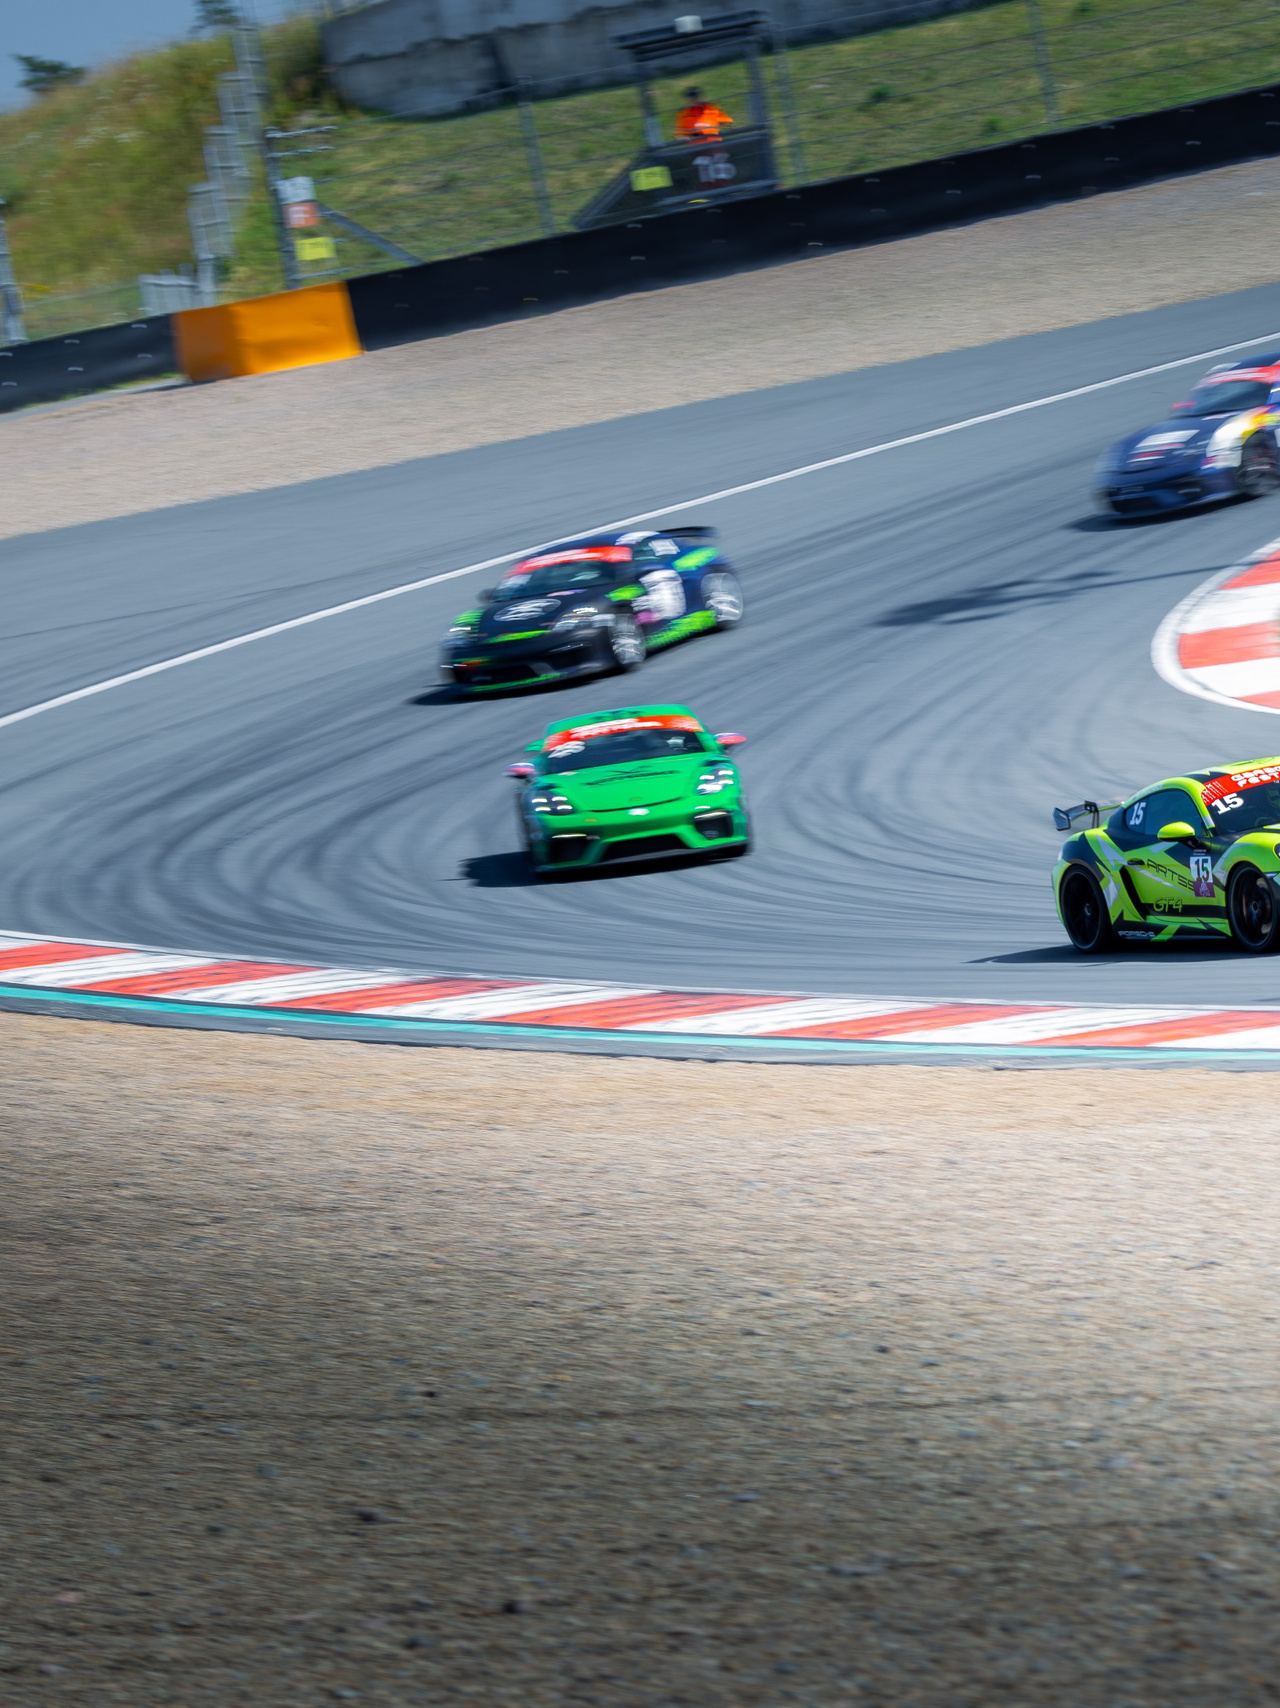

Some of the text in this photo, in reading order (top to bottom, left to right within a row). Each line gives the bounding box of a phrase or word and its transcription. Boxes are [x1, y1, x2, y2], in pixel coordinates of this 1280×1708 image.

[1129, 802, 1147, 826] 15
[1211, 792, 1244, 815] 15
[1194, 858, 1210, 882] 15
[1153, 896, 1183, 913] GT4
